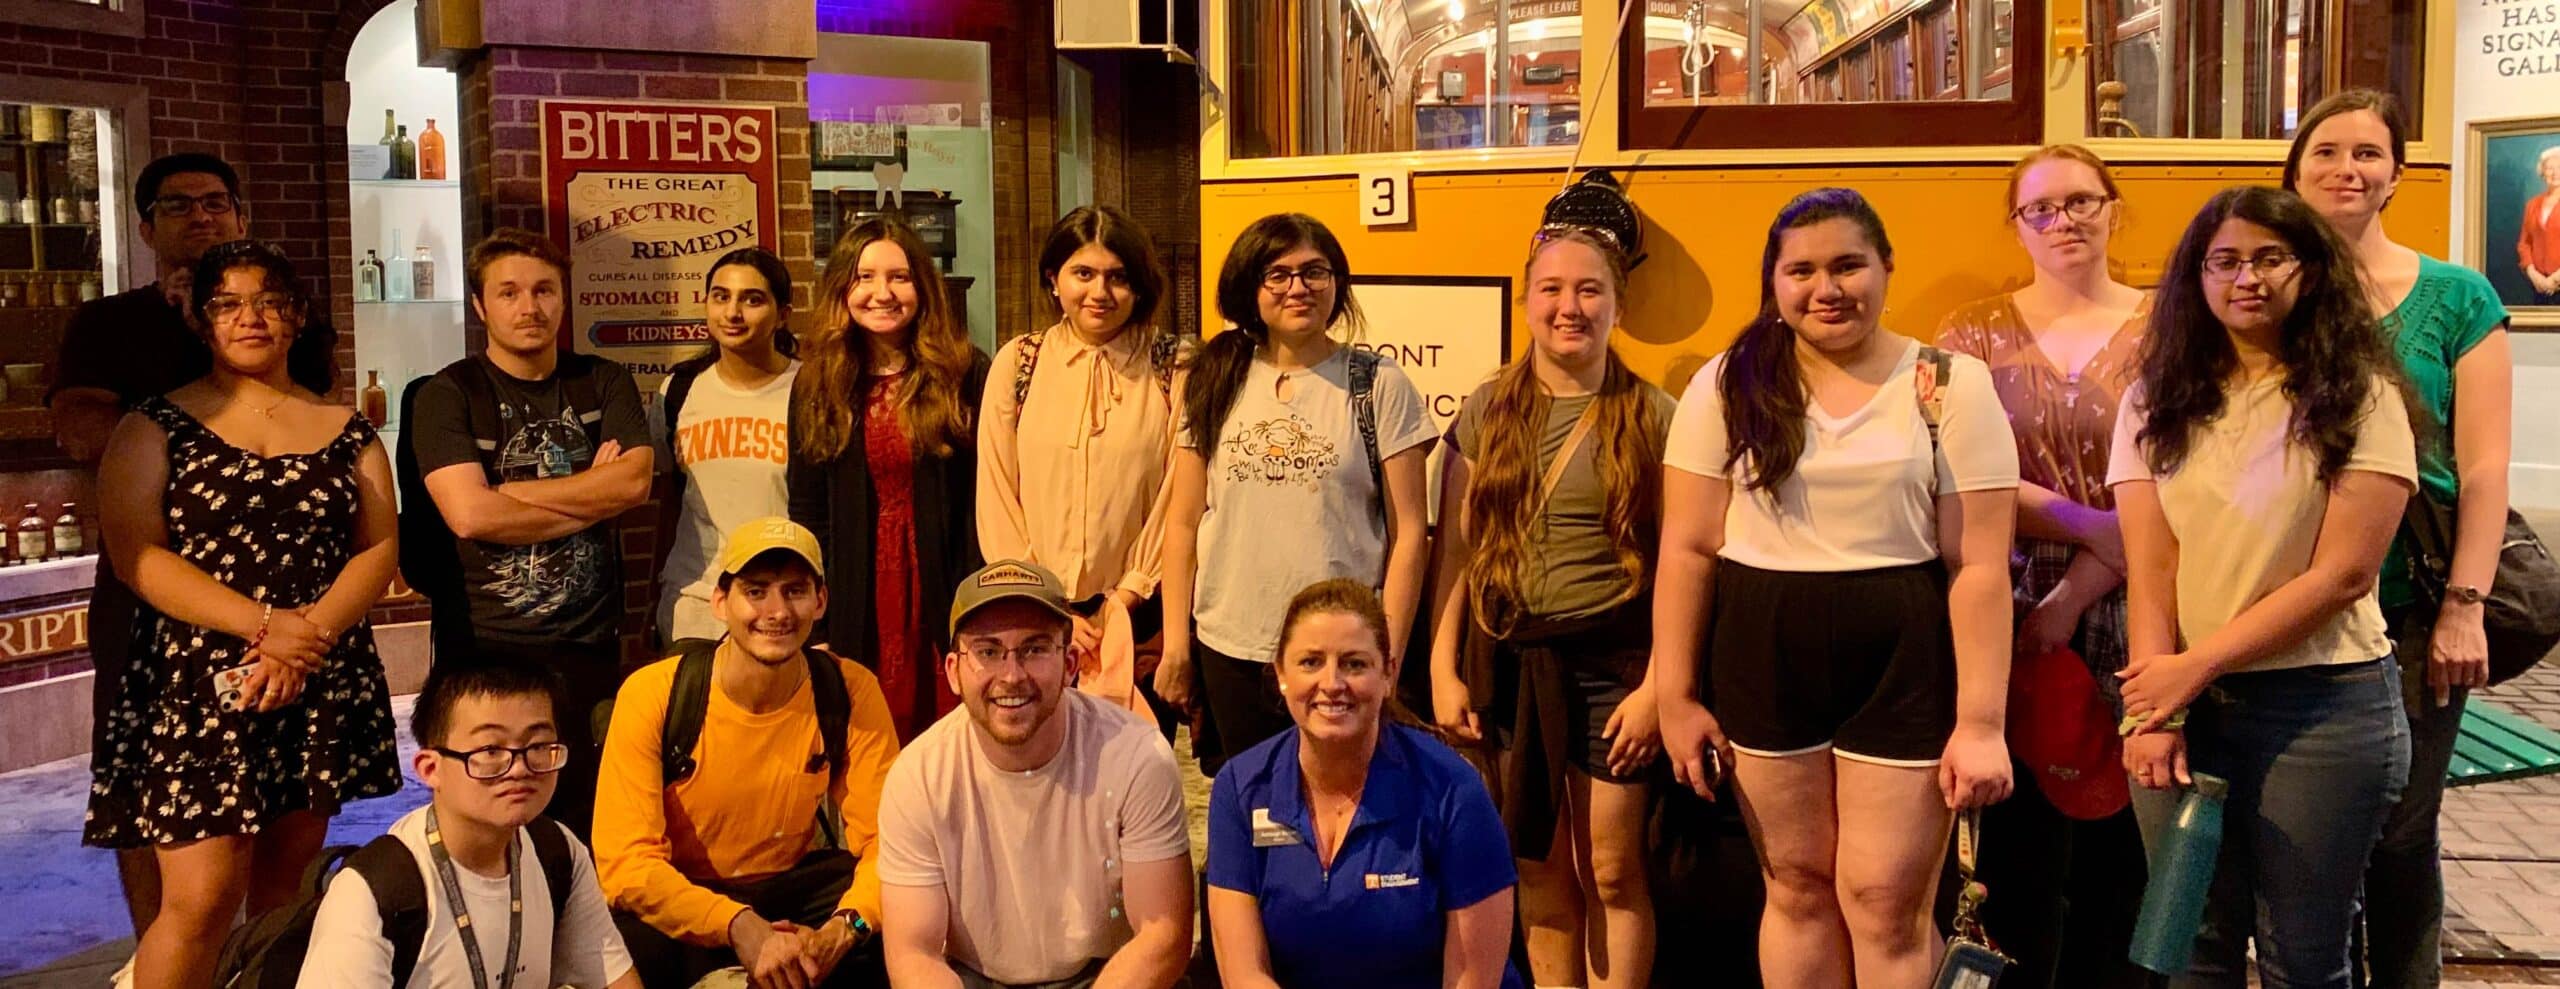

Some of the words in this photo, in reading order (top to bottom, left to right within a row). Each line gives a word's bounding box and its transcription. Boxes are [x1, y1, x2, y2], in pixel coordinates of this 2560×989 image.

[1509, 4, 1545, 19] PLEASE
[1550, 3, 1579, 14] LEAVE
[1650, 4, 1677, 15] DOOR
[2502, 4, 2556, 27] HAS
[560, 110, 762, 164] BITTERS
[604, 177, 650, 191] THE
[655, 178, 728, 191] GREAT
[1372, 177, 1394, 216] 3
[573, 202, 716, 244] ELECTRIC
[630, 220, 756, 260] REMEDY
[588, 272, 626, 282] CURES
[629, 272, 649, 282] ALL
[652, 271, 702, 281] DISEASES
[579, 290, 680, 306] STOMACH
[660, 309, 679, 318] AND
[626, 325, 709, 341] KIDNEYS
